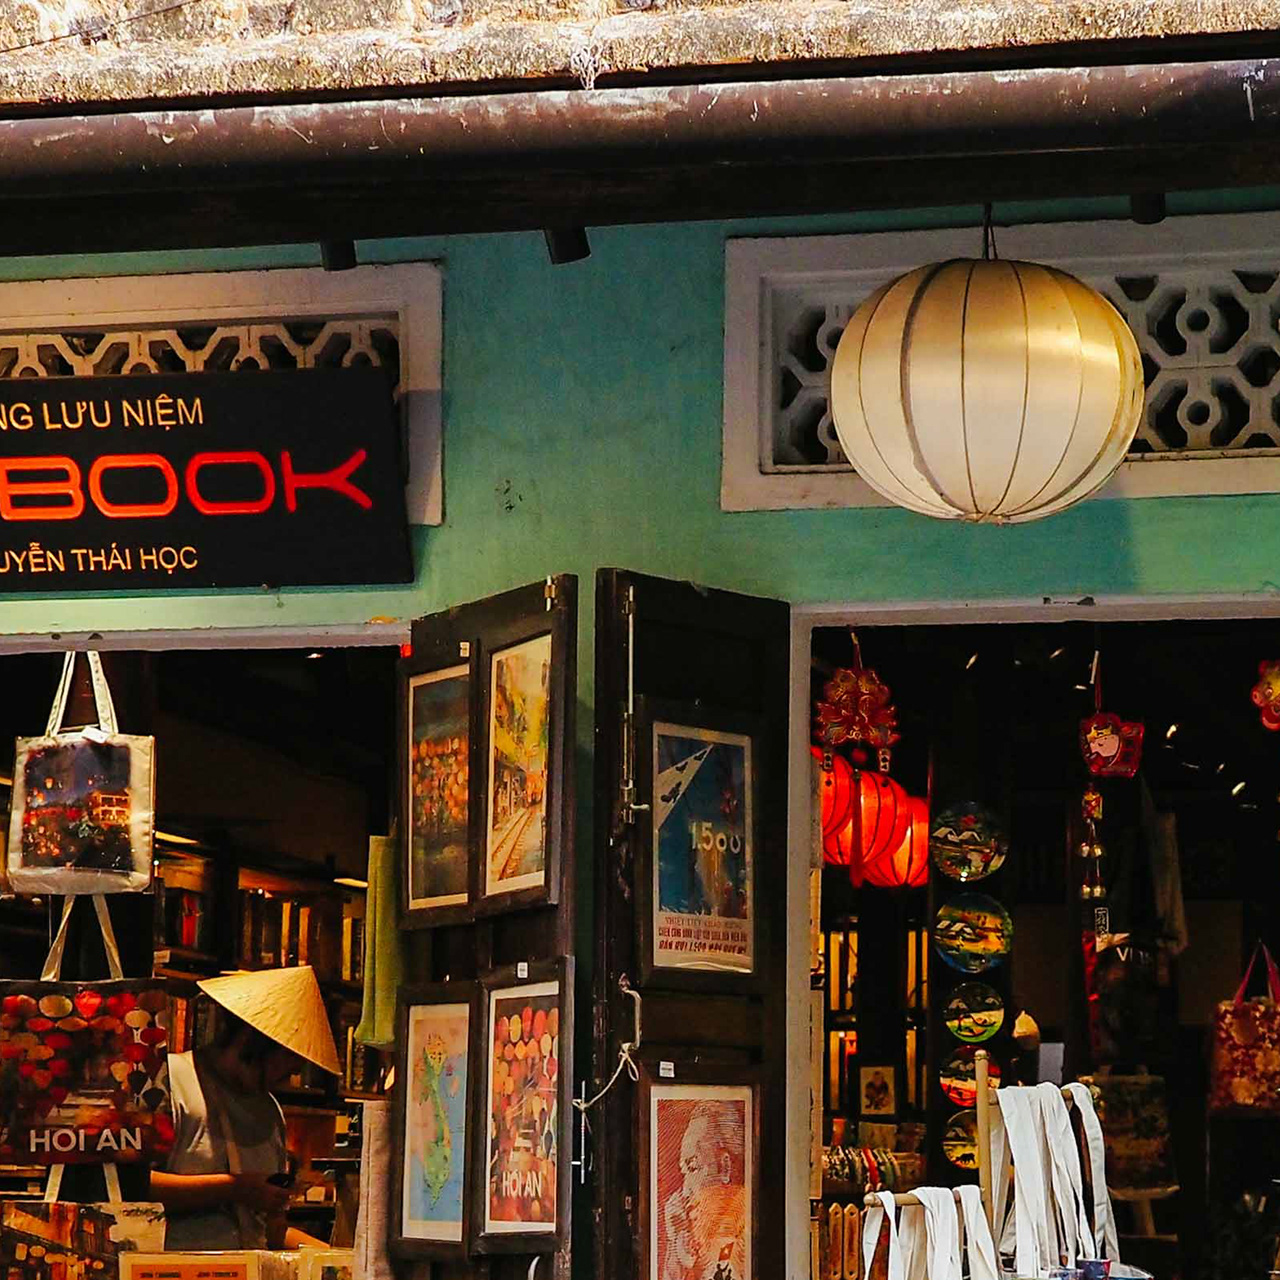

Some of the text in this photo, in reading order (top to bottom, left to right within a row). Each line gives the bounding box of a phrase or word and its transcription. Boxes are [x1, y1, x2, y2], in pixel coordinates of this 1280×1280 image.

[42, 399, 111, 431] LƯU
[122, 395, 204, 432] NIỆM
[72, 545, 132, 573] THÁI
[139, 546, 199, 576] HỌC
[30, 1127, 142, 1152] HOI AN
[523, 1170, 542, 1198] AN
